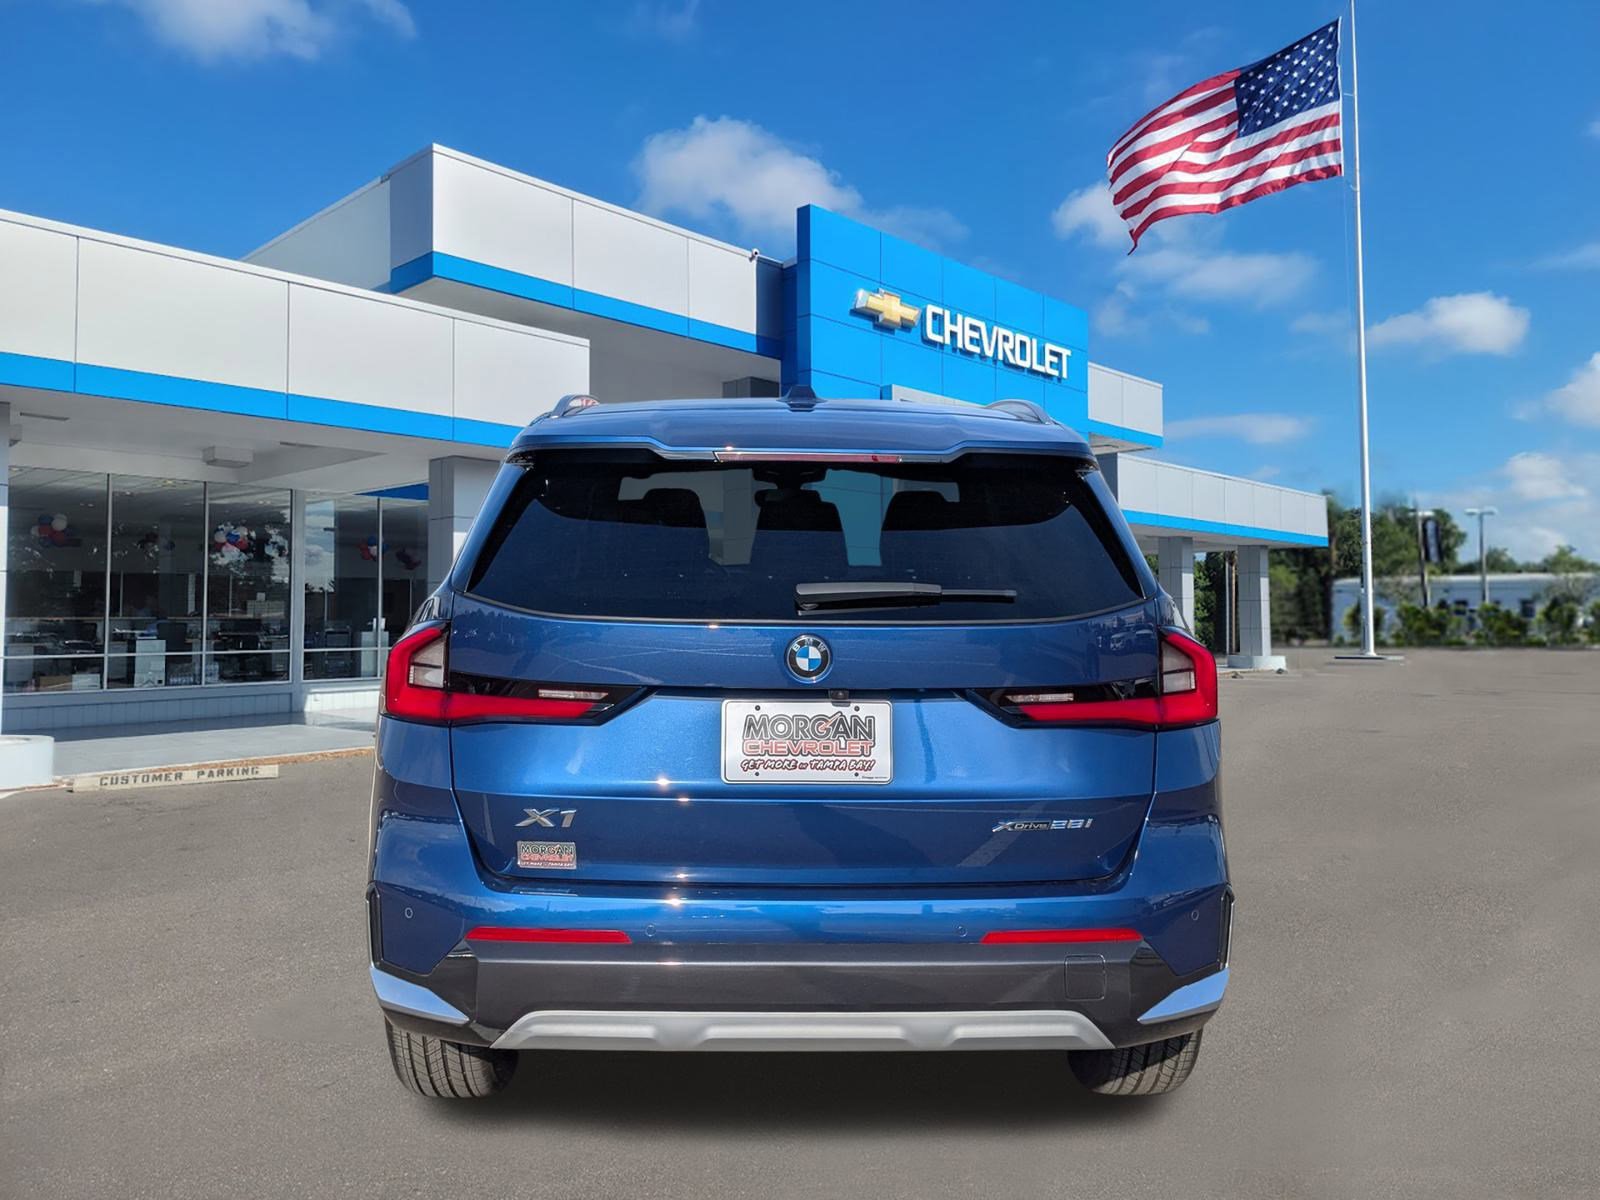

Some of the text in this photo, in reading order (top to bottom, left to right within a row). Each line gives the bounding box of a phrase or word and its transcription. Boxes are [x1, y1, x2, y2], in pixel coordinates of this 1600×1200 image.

[925, 304, 1072, 378] CHEVROLET
[791, 638, 827, 652] BMW
[744, 713, 874, 740] MORGAN
[743, 740, 874, 755] CHEVROLET
[741, 759, 764, 771] GET
[763, 759, 798, 770] MORE
[809, 759, 847, 771] TAMPA
[848, 759, 876, 771] BAY!
[100, 766, 259, 786] CUSTOMER PARKING
[514, 808, 577, 828] X1
[521, 844, 573, 855] MORGAN
